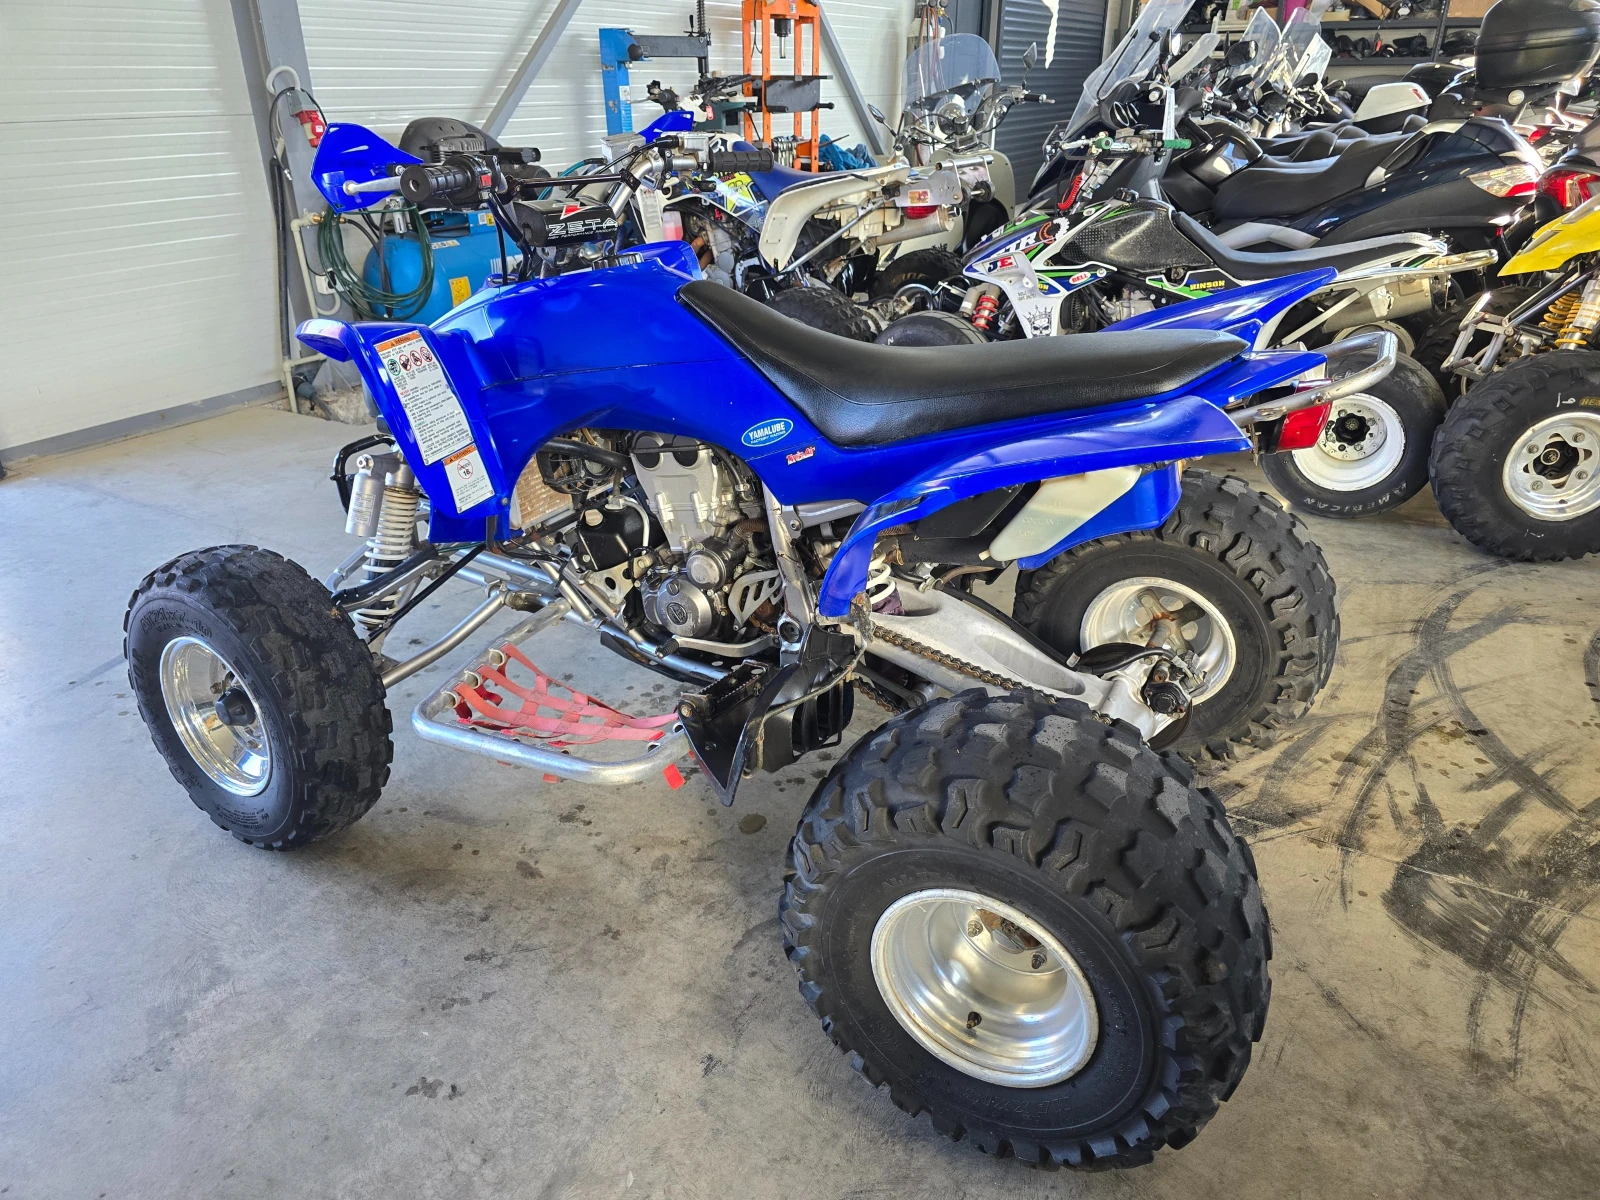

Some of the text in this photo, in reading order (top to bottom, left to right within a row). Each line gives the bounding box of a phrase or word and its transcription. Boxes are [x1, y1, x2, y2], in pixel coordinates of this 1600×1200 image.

[548, 217, 618, 237] ZETA
[987, 256, 1013, 272] JE
[1071, 273, 1089, 284] BELL
[1189, 280, 1226, 291] HINSON
[749, 421, 785, 440] YAMALUBE
